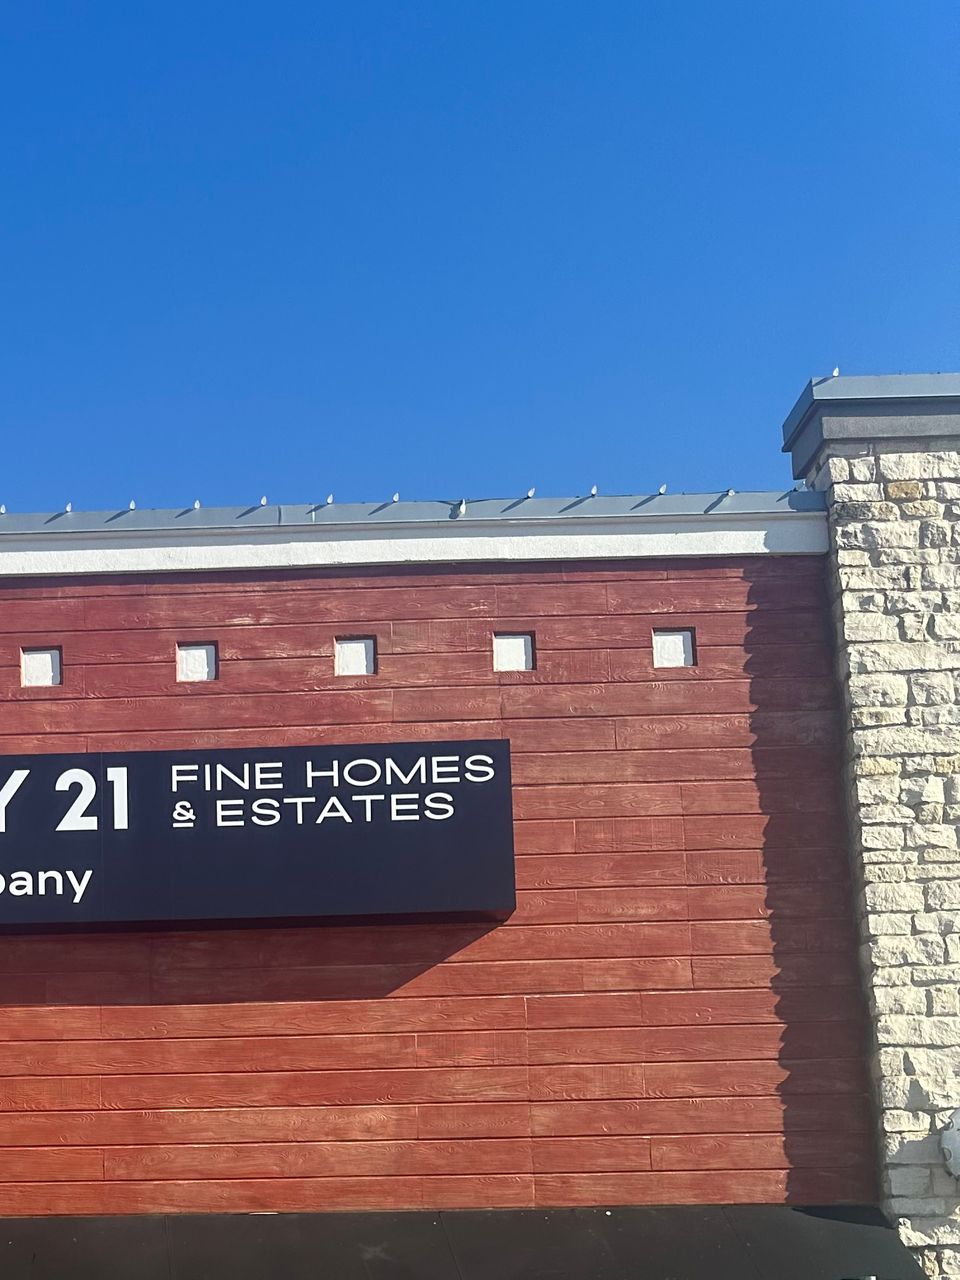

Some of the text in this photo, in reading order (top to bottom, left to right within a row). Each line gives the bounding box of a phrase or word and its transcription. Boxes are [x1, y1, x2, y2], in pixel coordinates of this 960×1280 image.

[172, 755, 495, 793] FINE HOMES
[55, 766, 129, 832] 21
[172, 792, 455, 829] & ESTATES
